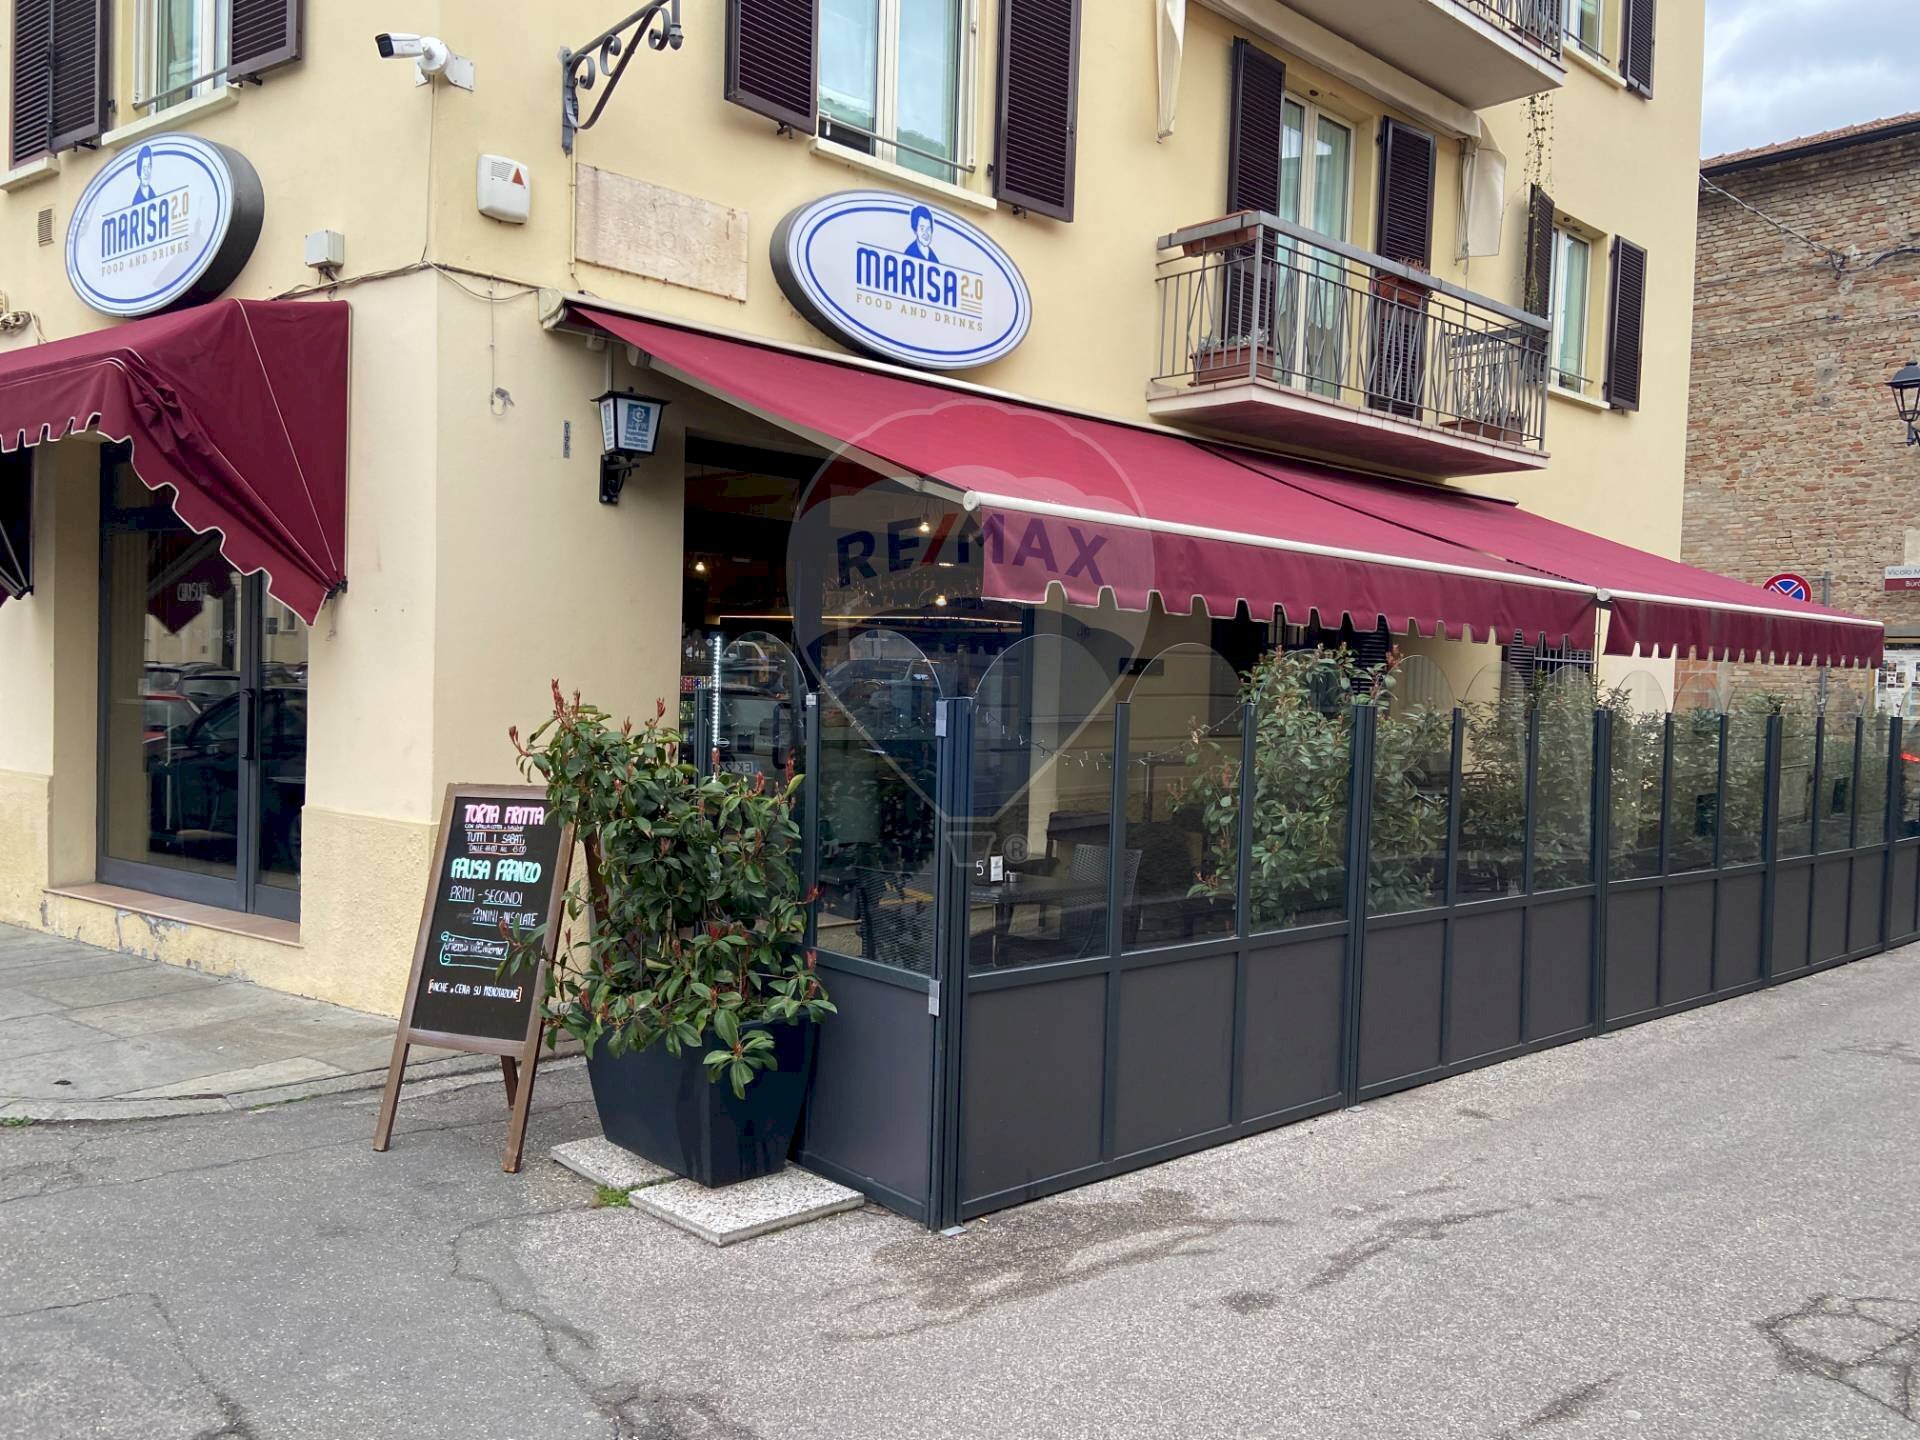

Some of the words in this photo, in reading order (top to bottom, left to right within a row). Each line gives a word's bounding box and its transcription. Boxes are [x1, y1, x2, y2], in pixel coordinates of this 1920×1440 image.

[102, 199, 168, 257] MARISA
[171, 192, 189, 219] 2.0
[102, 261, 124, 277] FOOD
[129, 254, 147, 268] AND
[152, 241, 189, 261] DRINKS
[857, 247, 957, 308] MARISA
[961, 275, 983, 300] 2.0
[856, 293, 892, 310] FOOD
[900, 304, 927, 318] AND
[935, 312, 983, 332] DRINKS
[465, 804, 500, 823] TORTA
[505, 806, 544, 825] FRITTA
[467, 832, 487, 842] TUTTI
[450, 857, 491, 879] PAUSA
[495, 859, 541, 883] PRANZO
[975, 860, 984, 876] 5
[450, 885, 475, 900] PRIMI
[484, 889, 523, 904] SECONDI
[472, 907, 498, 922] PANINI
[454, 983, 471, 994] CENA
[473, 985, 482, 995] SU
